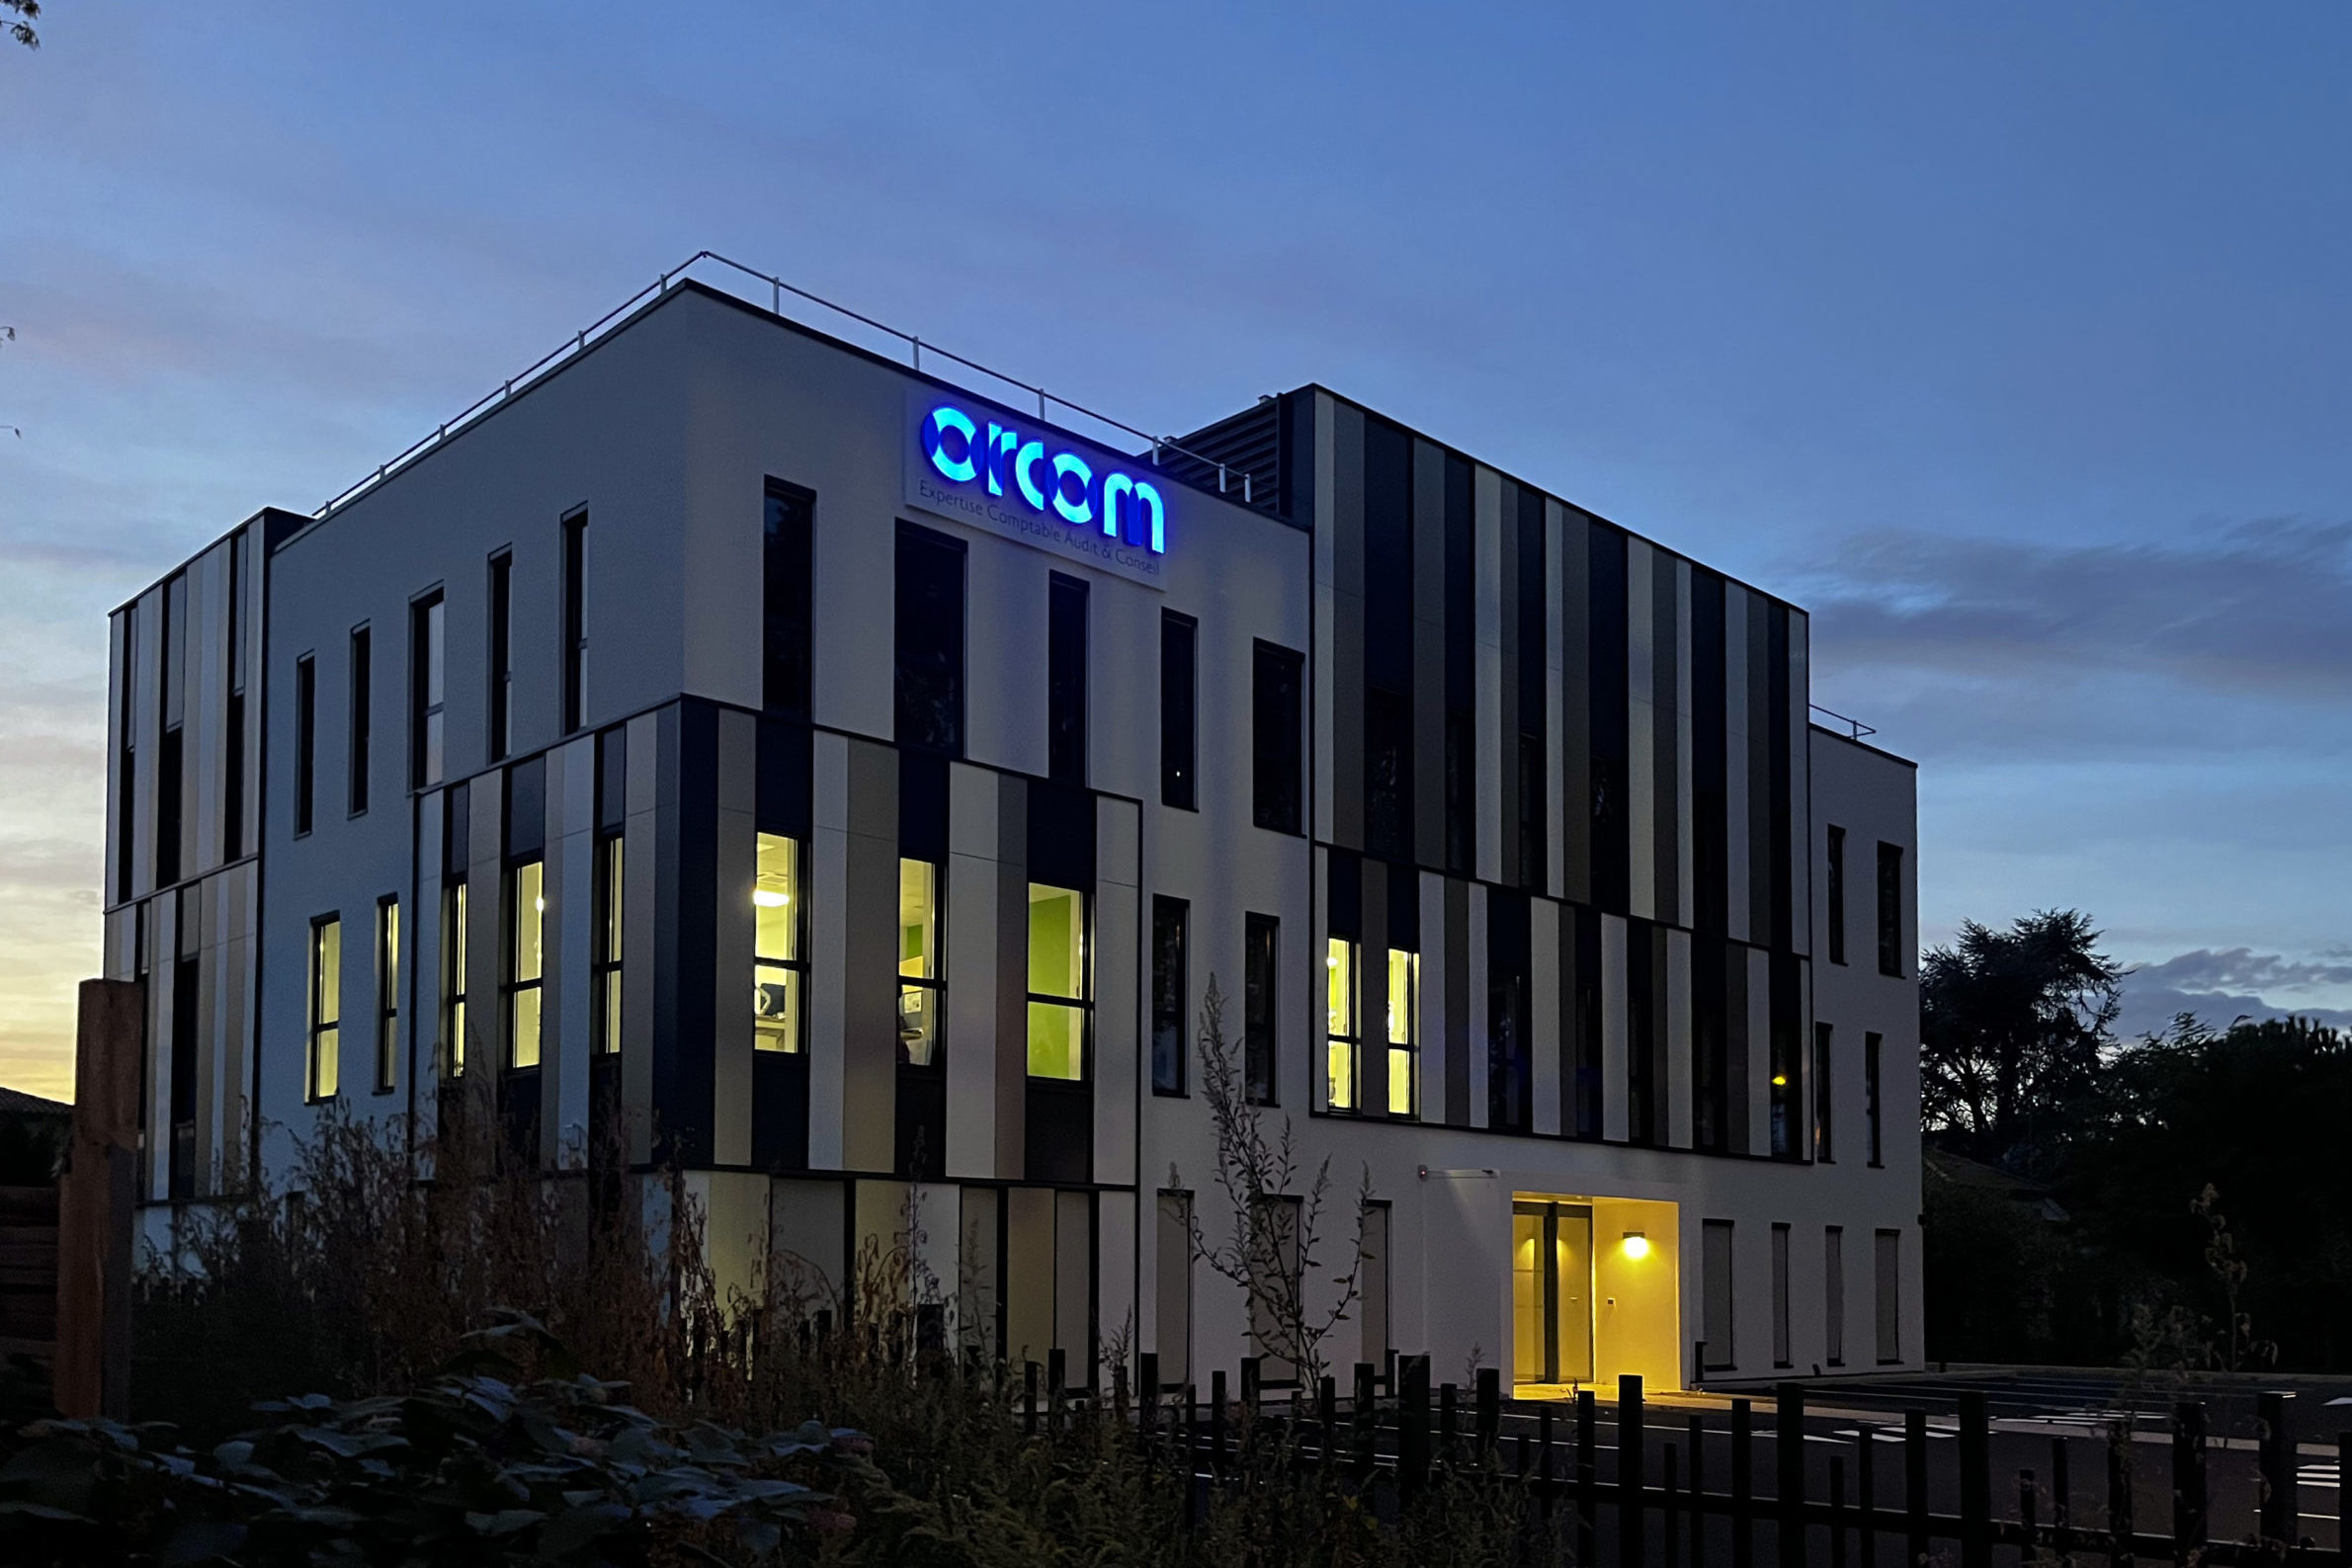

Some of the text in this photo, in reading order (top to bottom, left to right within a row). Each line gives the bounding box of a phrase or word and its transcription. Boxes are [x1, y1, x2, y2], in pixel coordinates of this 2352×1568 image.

[919, 480, 1160, 576] Expertise Comptable Audit & Conseil
[922, 406, 1164, 553] orcom
